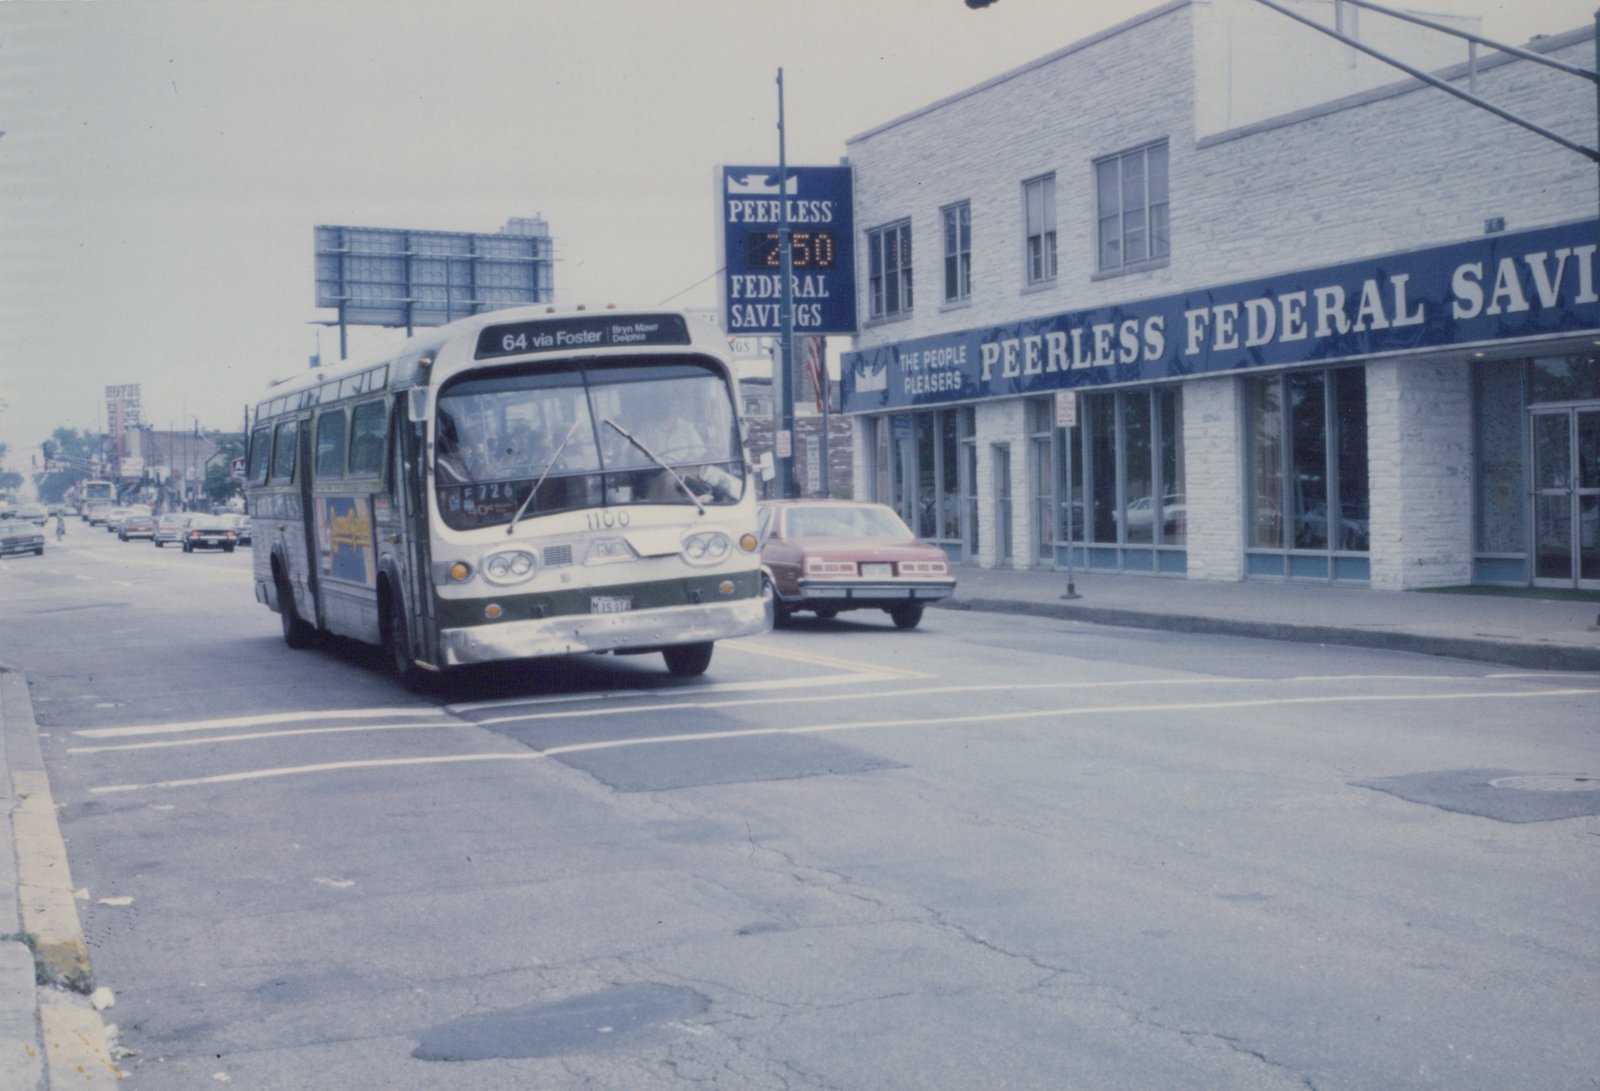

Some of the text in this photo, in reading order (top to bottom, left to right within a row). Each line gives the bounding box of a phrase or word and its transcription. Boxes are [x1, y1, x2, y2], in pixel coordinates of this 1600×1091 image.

[729, 200, 833, 223] PEERLESS
[981, 244, 1599, 382] PEERLESS FEDERAL SAVI
[502, 330, 602, 351] 64 via Foster
[612, 325, 633, 335] Bryn
[900, 345, 967, 372] THE PEOPLE
[904, 370, 962, 395] PLEASERS
[586, 510, 631, 531] 1100
